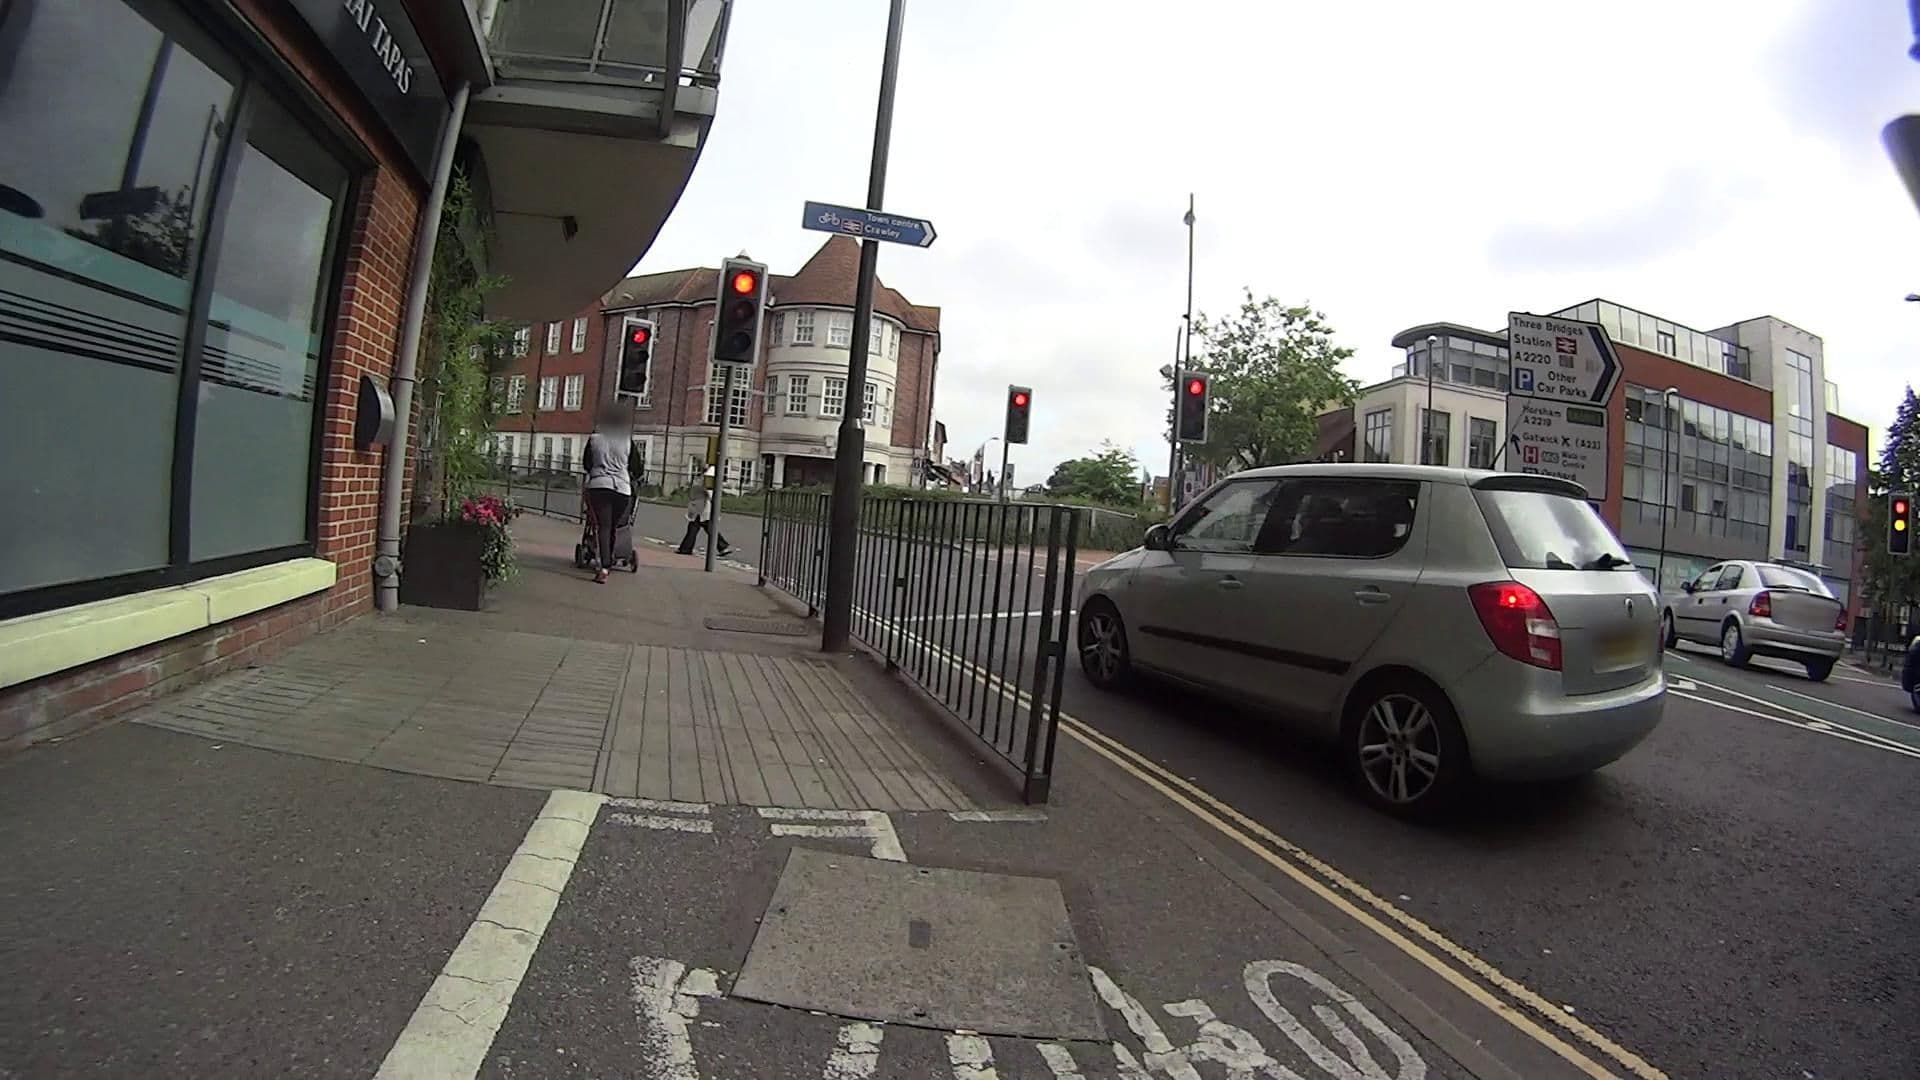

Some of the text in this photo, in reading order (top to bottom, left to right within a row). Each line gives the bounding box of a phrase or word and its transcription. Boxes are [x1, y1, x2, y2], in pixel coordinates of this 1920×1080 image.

[343, 0, 413, 94] AI TAPAS
[867, 213, 890, 225] Town
[864, 224, 901, 239] Crawley
[1512, 316, 1584, 336] Three Bridges
[1513, 333, 1553, 348] Station
[1514, 351, 1551, 364] A2220
[1547, 371, 1577, 383] Other
[1537, 381, 1588, 398] Car Parks
